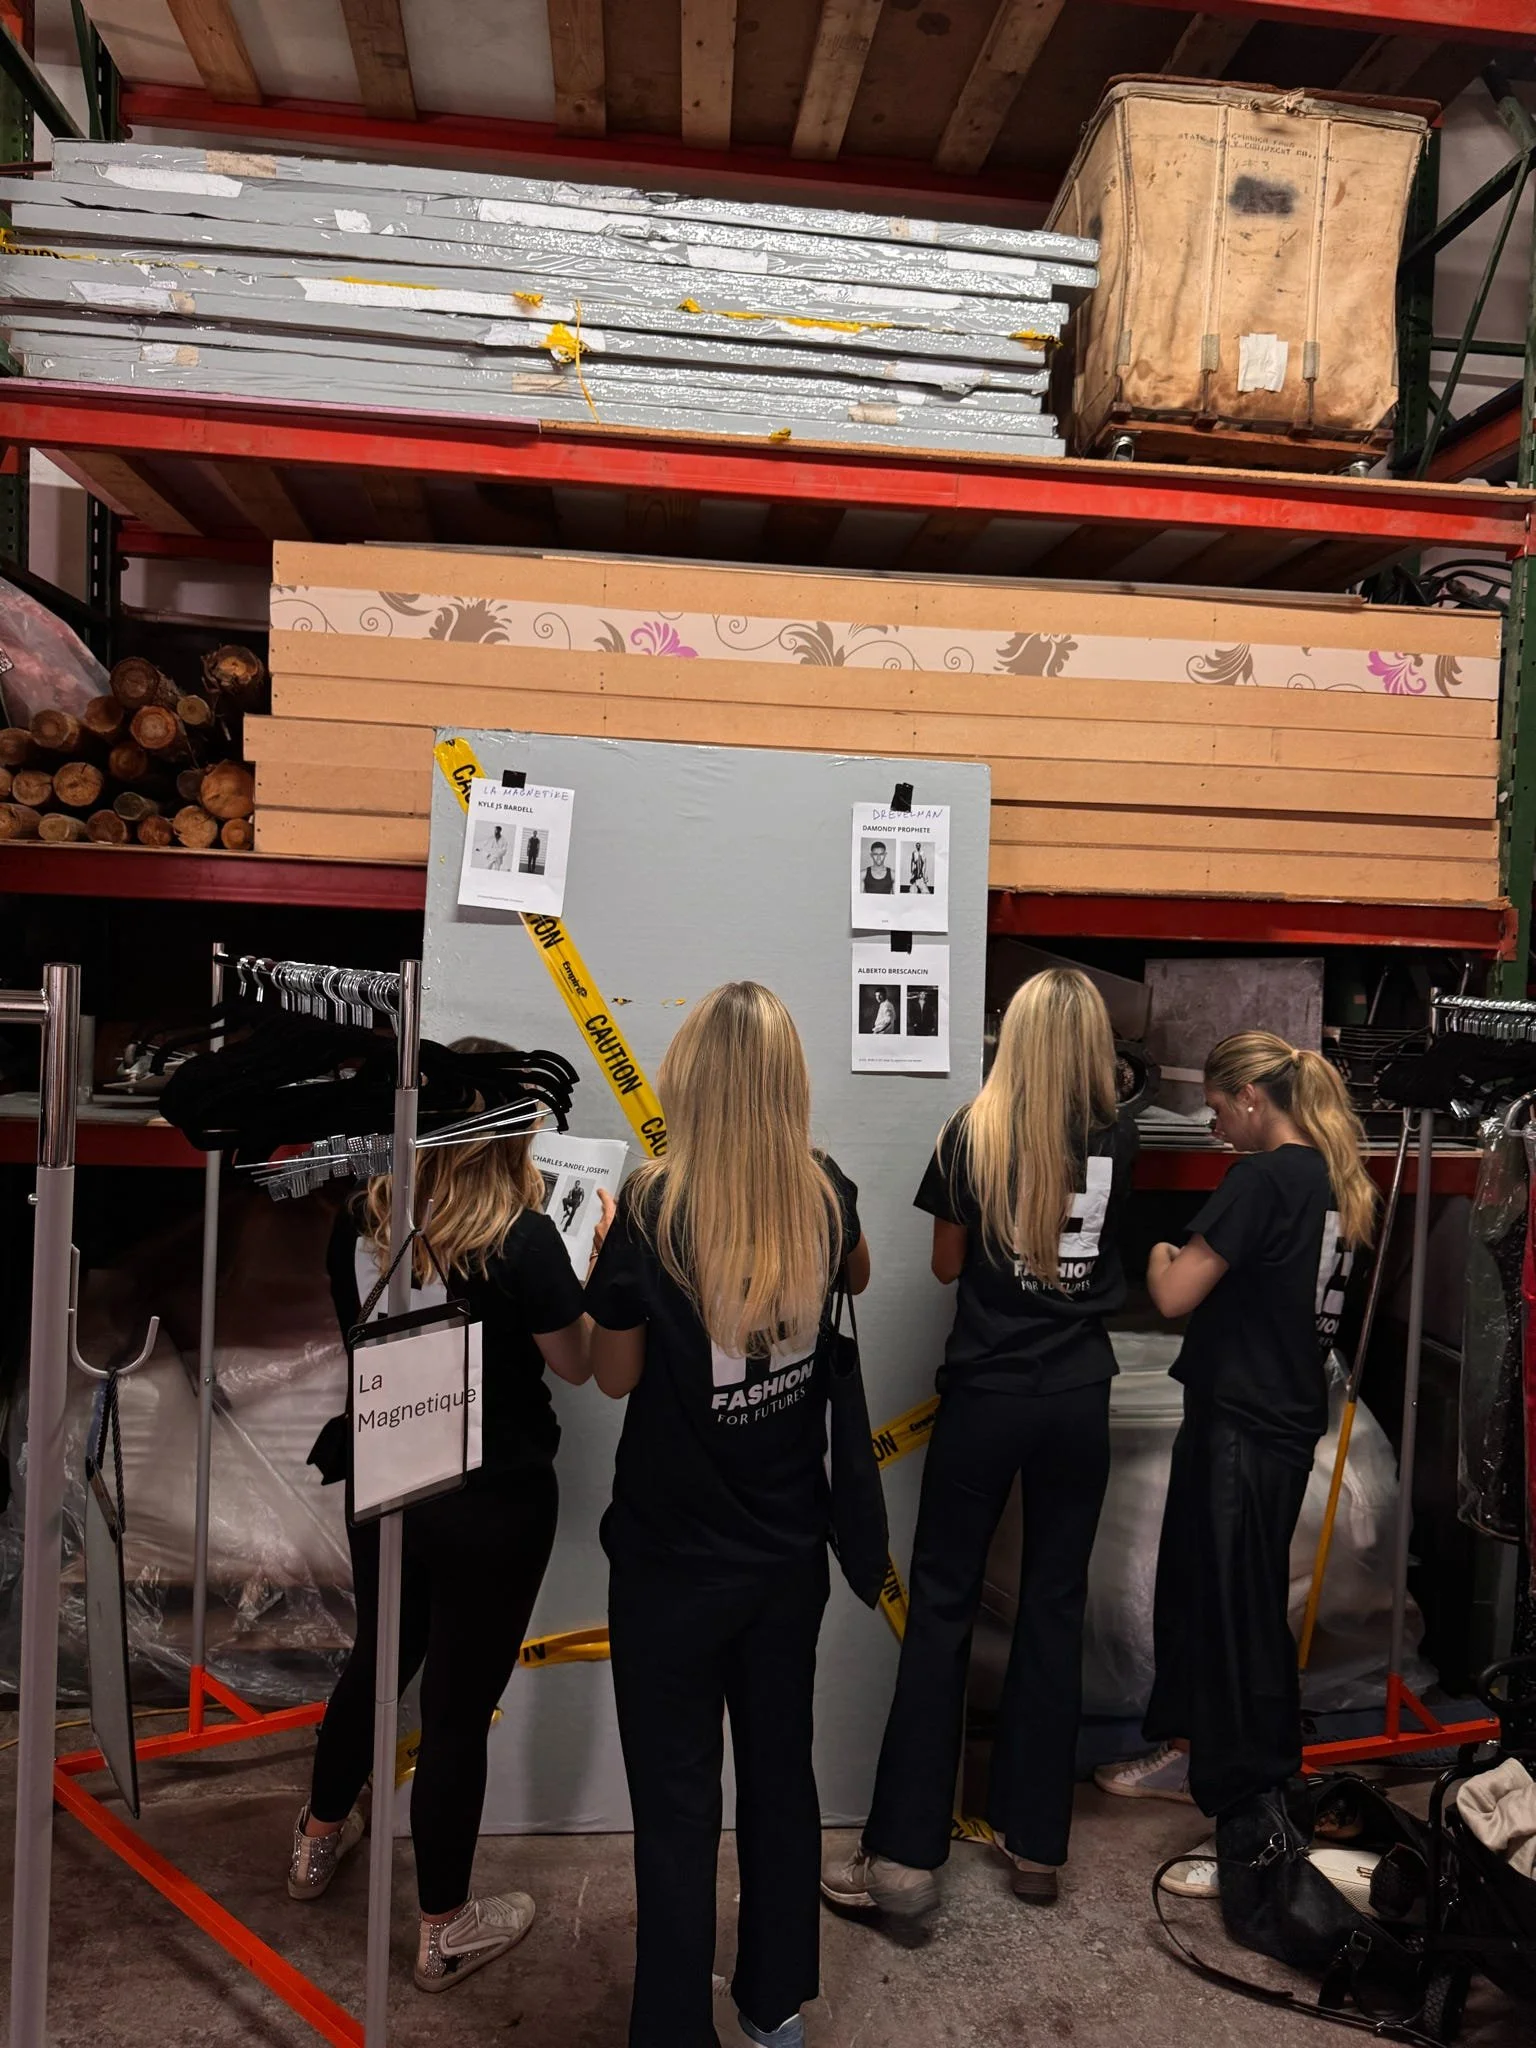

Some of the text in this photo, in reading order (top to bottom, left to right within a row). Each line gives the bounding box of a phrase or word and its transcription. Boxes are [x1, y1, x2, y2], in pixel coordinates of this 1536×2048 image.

[495, 803, 503, 811] JS
[503, 805, 534, 814] BARDELL
[897, 826, 931, 834] PROPHETE
[857, 967, 929, 976] ALBERTO BRESCANCIN
[585, 1014, 643, 1095] CAUTION
[532, 1154, 610, 1175] CHARLES ANDEL JOSEPH
[359, 1374, 383, 1394] La
[711, 1359, 815, 1411] FASHION
[357, 1387, 477, 1432] Magnetique
[717, 1385, 806, 1425] FOR FUTURES
